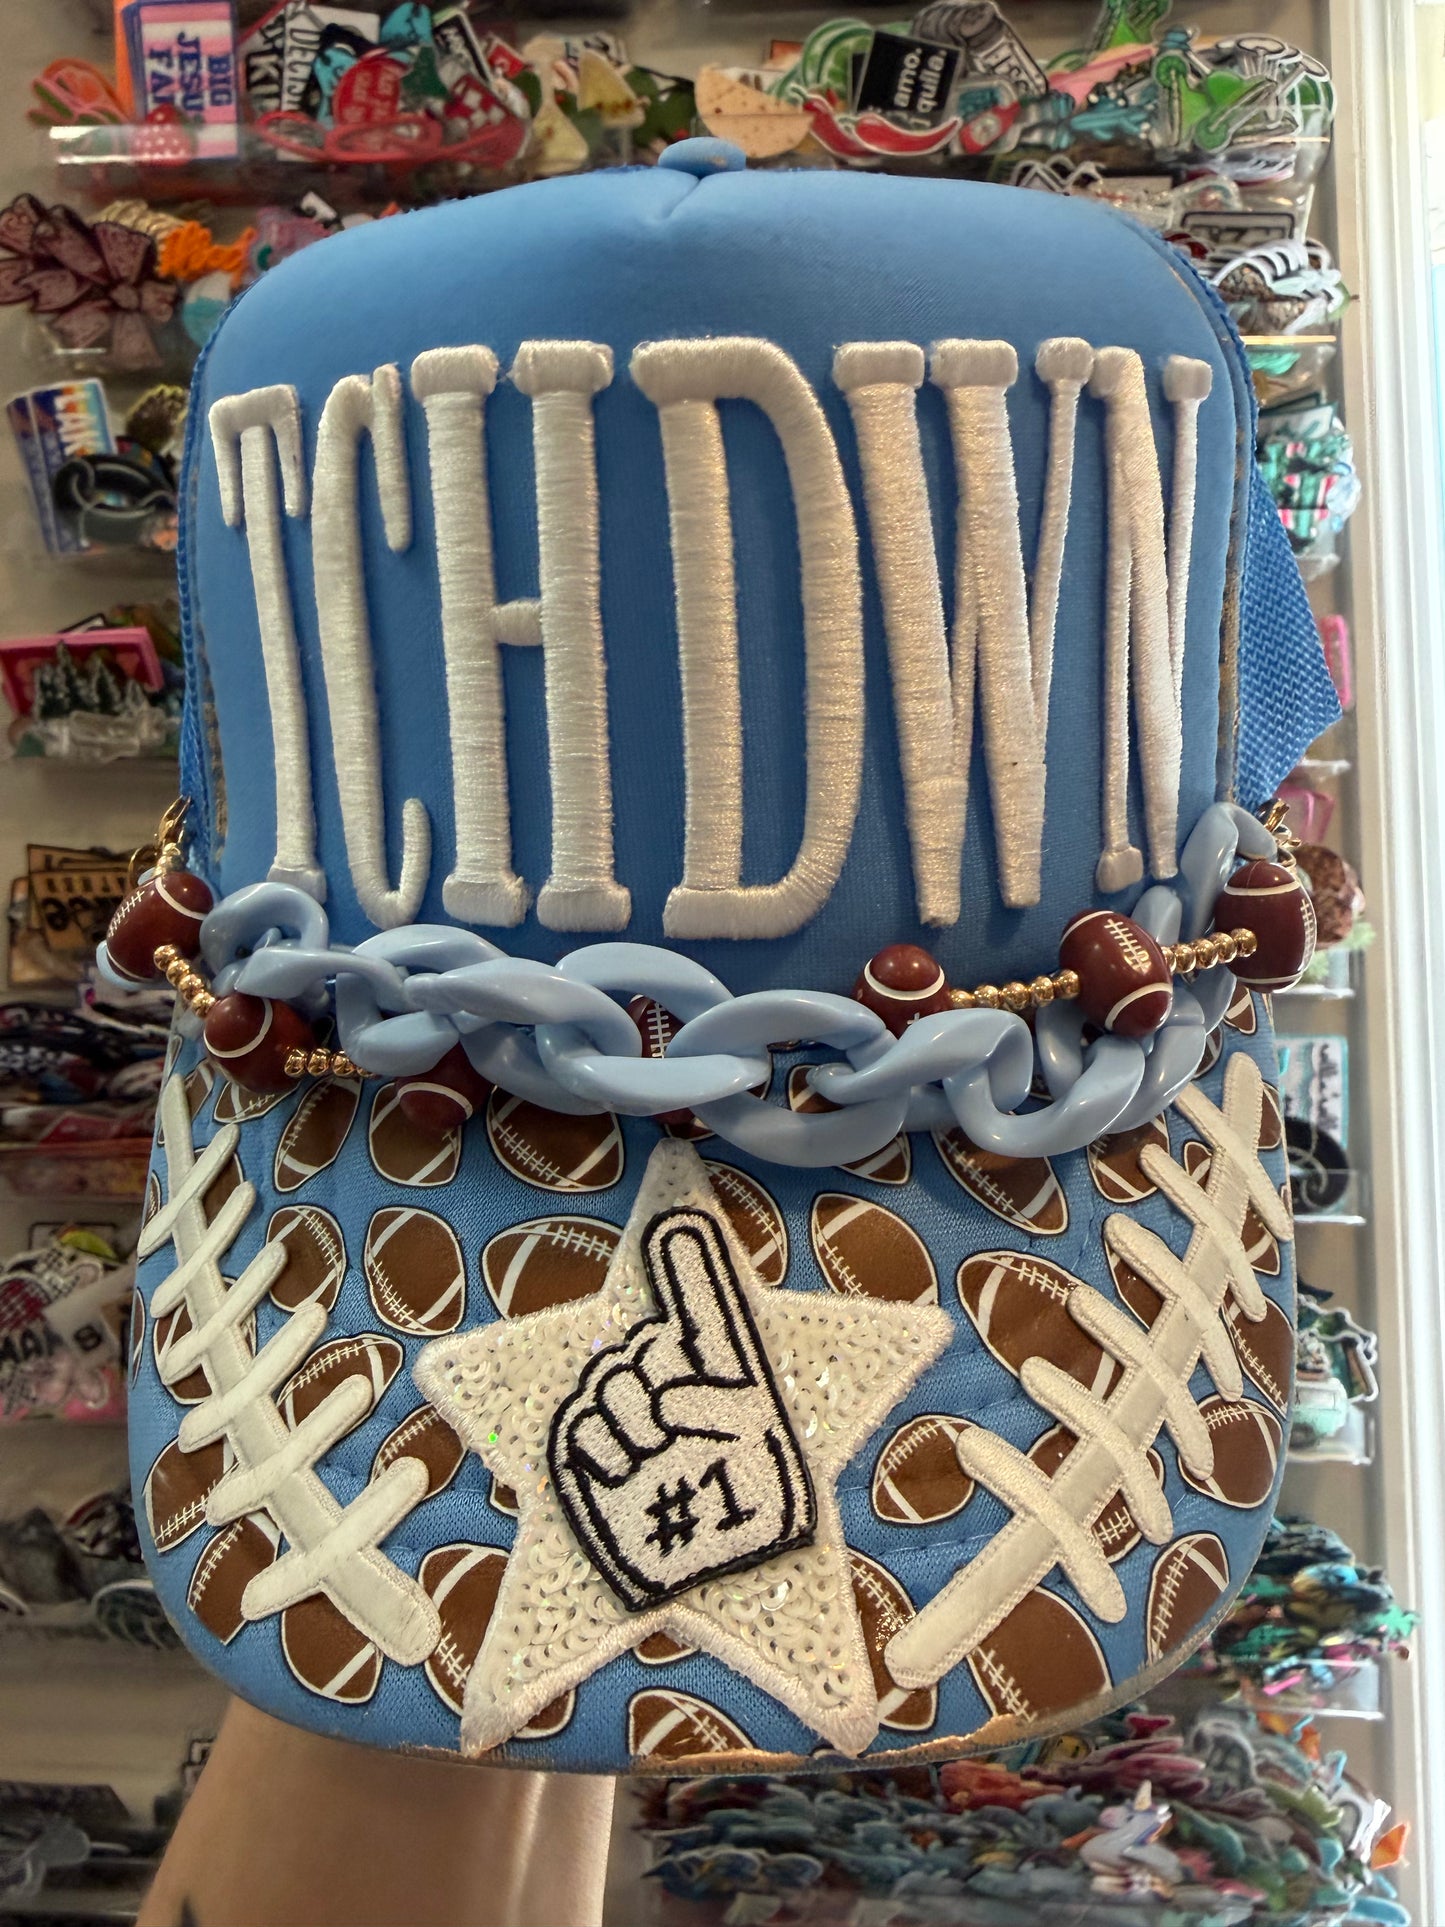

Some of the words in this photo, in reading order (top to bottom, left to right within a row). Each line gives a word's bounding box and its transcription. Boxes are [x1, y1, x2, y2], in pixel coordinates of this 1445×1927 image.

[177, 31, 204, 114] JESU
[208, 55, 234, 107] BIG
[893, 47, 924, 109] amo.
[55, 391, 101, 457] LAK
[208, 335, 1213, 940] TCHDWN
[644, 1457, 757, 1558] #1
